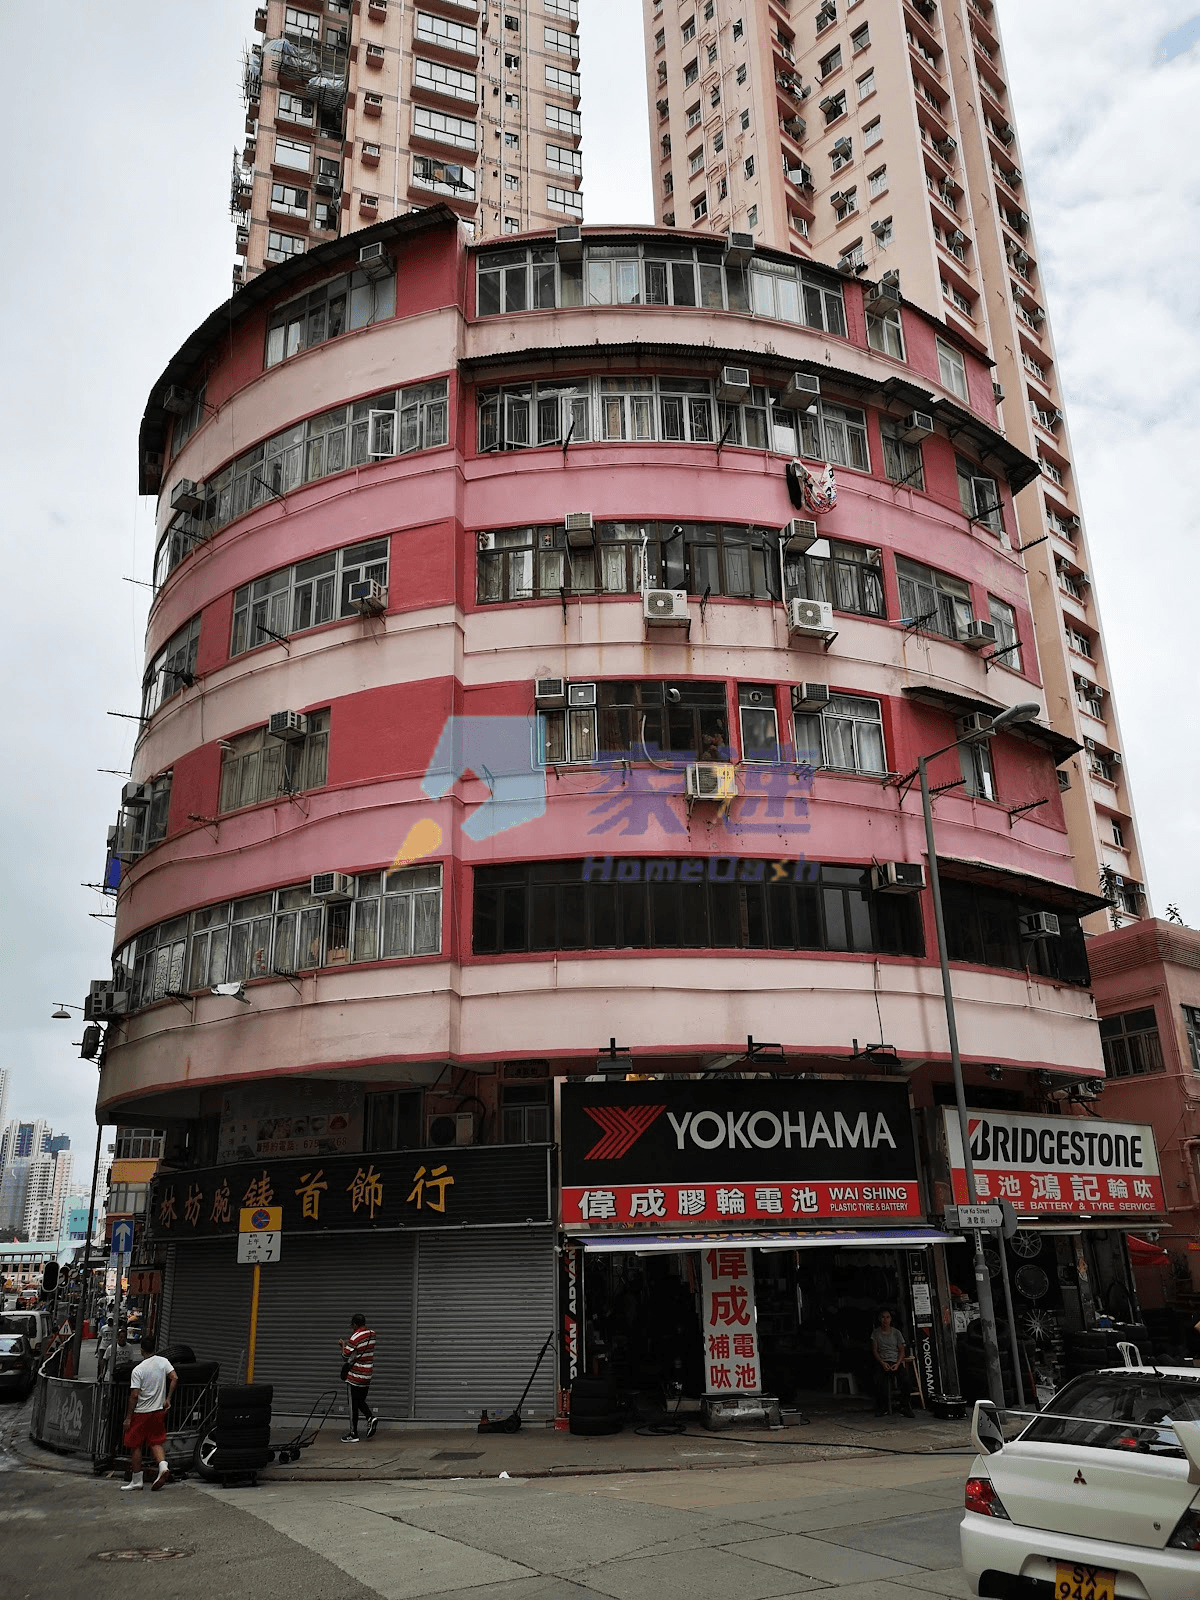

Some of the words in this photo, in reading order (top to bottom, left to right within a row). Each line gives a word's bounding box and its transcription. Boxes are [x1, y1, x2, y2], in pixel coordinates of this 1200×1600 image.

[666, 1110, 897, 1150] YOKOHAMA
[969, 1119, 1143, 1168] BRIDGESTONE
[577, 1186, 820, 1220] 偉成膠輪電池
[828, 1187, 859, 1201] WAI
[862, 1186, 908, 1200] SHING
[830, 1203, 858, 1212] PLASTIC
[858, 1203, 875, 1211] TYRE
[875, 1203, 881, 1211] &
[881, 1202, 908, 1211] BATTERY
[1030, 1202, 1073, 1210] BATTERY
[1091, 1202, 1115, 1211] TYRE
[1119, 1202, 1156, 1211] SERVICE
[266, 1233, 274, 1244] 7
[265, 1249, 273, 1261] 7
[706, 1248, 751, 1327] 偉成
[569, 1323, 579, 1388] DVAN
[1073, 1564, 1098, 1588] SX
